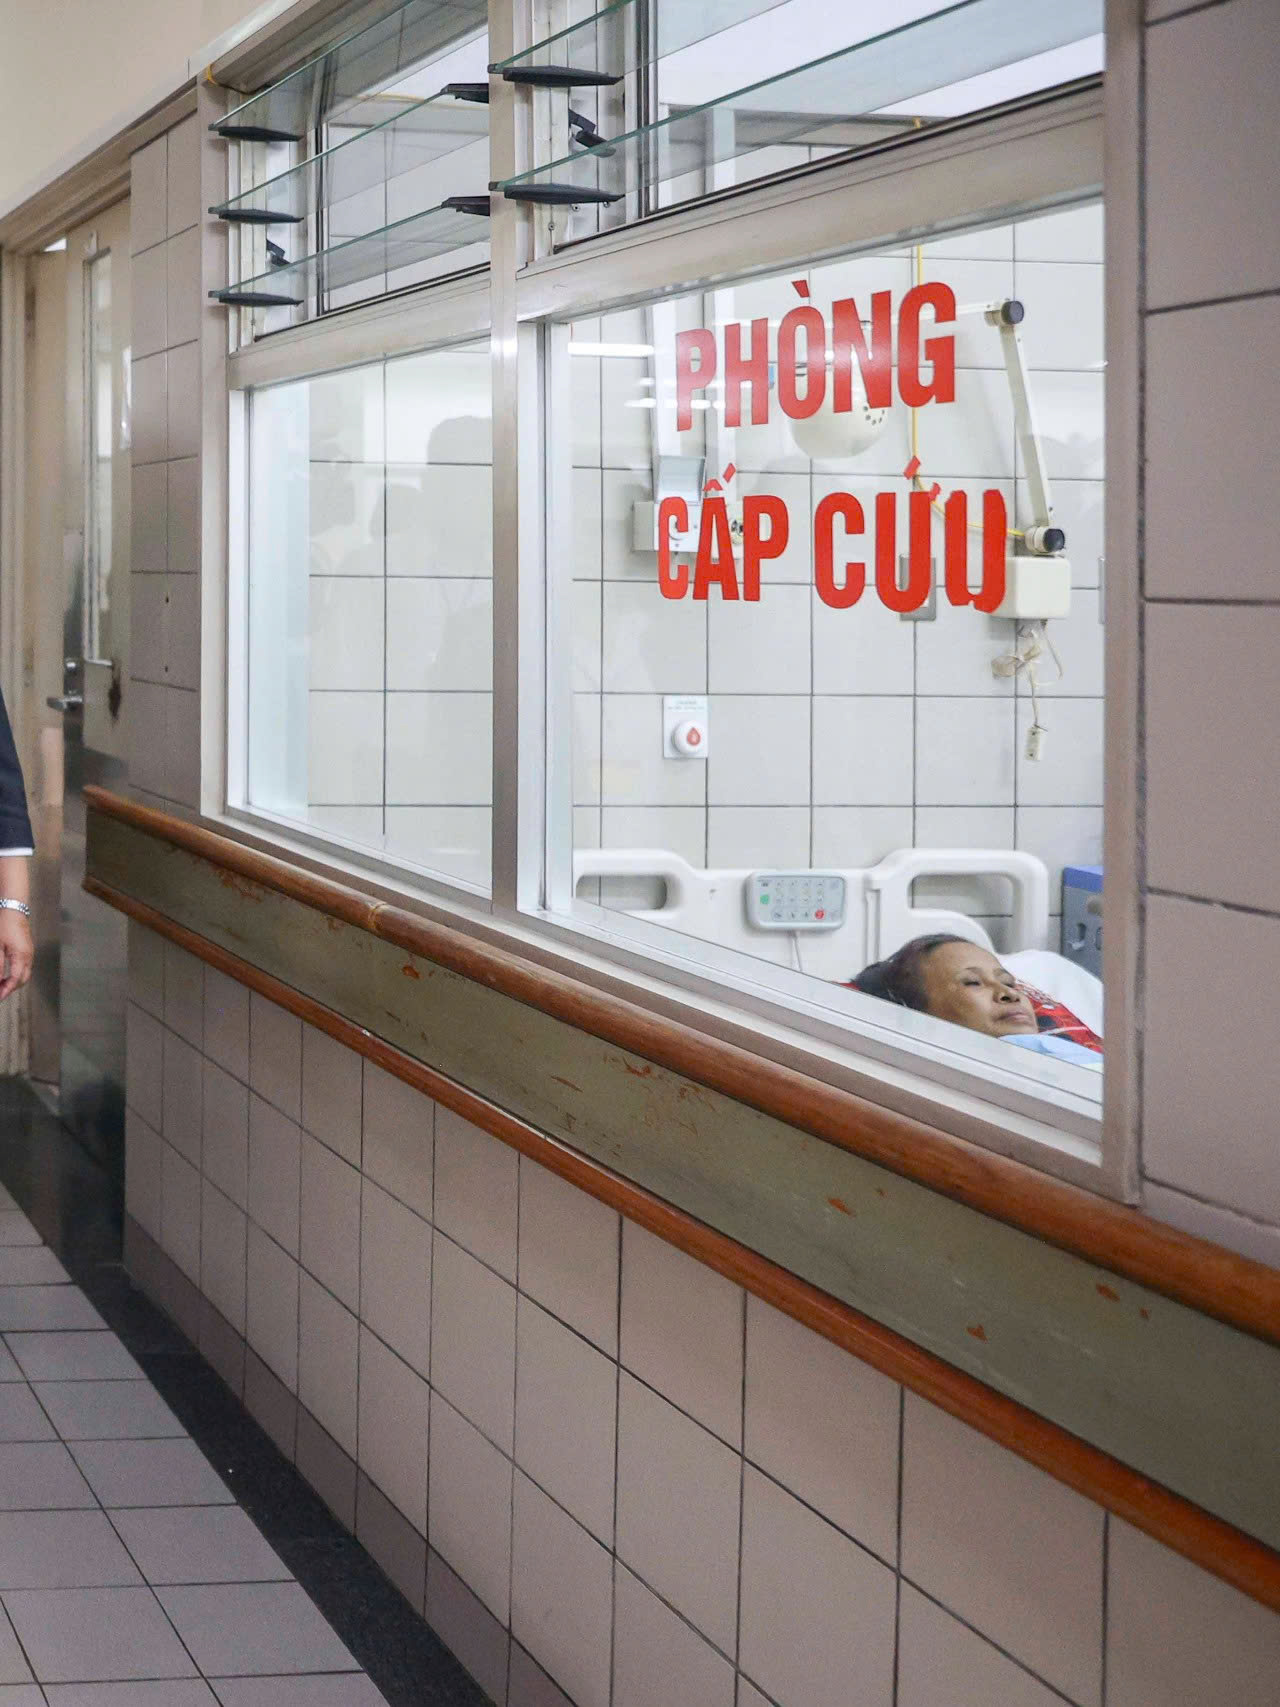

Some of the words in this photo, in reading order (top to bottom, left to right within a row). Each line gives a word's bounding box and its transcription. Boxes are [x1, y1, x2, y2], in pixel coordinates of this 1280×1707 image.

[675, 279, 957, 432] PHÒNG
[657, 462, 790, 602] CẤP
[814, 455, 1008, 614] CỨU
